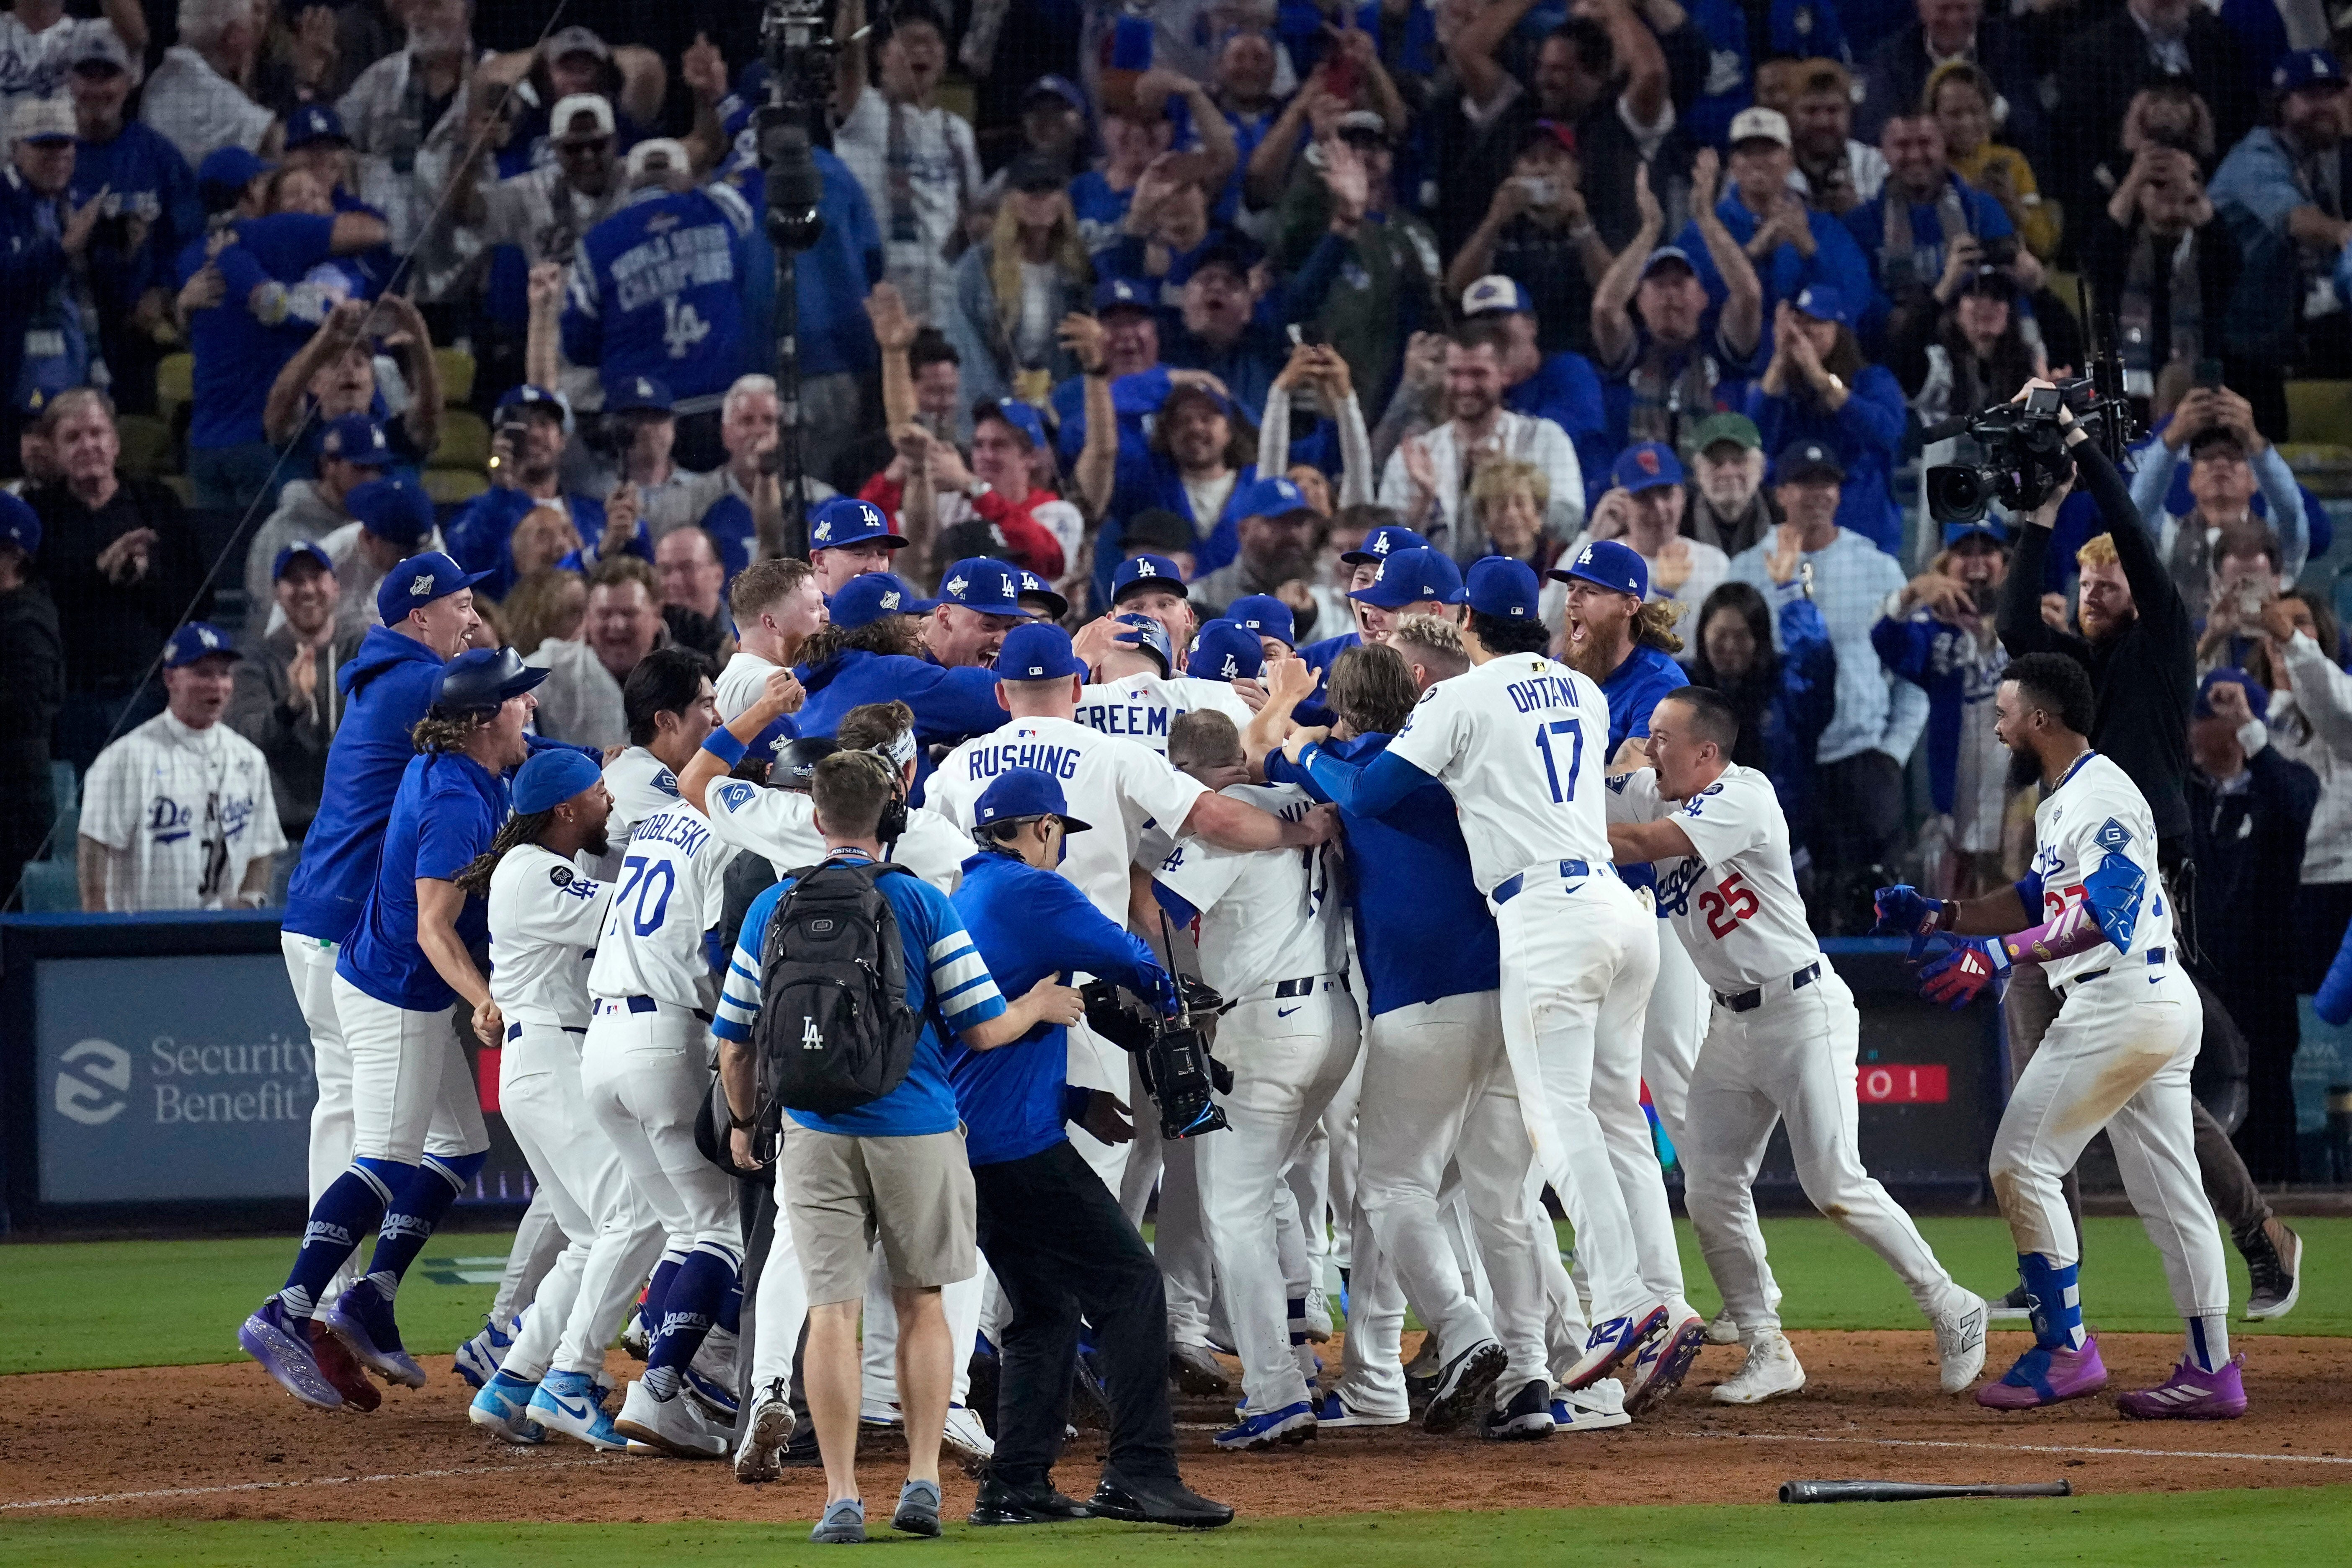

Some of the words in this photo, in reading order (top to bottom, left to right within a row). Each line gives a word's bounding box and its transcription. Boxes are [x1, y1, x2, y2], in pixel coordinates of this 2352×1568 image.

[859, 505, 880, 527] LA
[1373, 531, 1390, 554] LA
[1578, 544, 1593, 565] LA
[1137, 557, 1156, 577] LA
[1375, 558, 1386, 581] LA
[1001, 573, 1015, 598] LA
[1020, 572, 1039, 590] LA
[1142, 633, 1151, 643] 5
[1221, 653, 1239, 678] LA
[1506, 676, 1579, 714] OHTANI
[1075, 704, 1186, 736] FREEM
[969, 744, 1081, 781] RUSHING
[1536, 718, 1583, 804] 17
[2105, 828, 2121, 841] G
[831, 847, 869, 857] POSTSEASON
[557, 869, 572, 885] 34
[609, 856, 675, 937] 70
[1699, 872, 1759, 940] 25
[802, 1016, 824, 1050] LA
[152, 1033, 315, 1081] Security
[156, 1082, 299, 1124] Benefit
